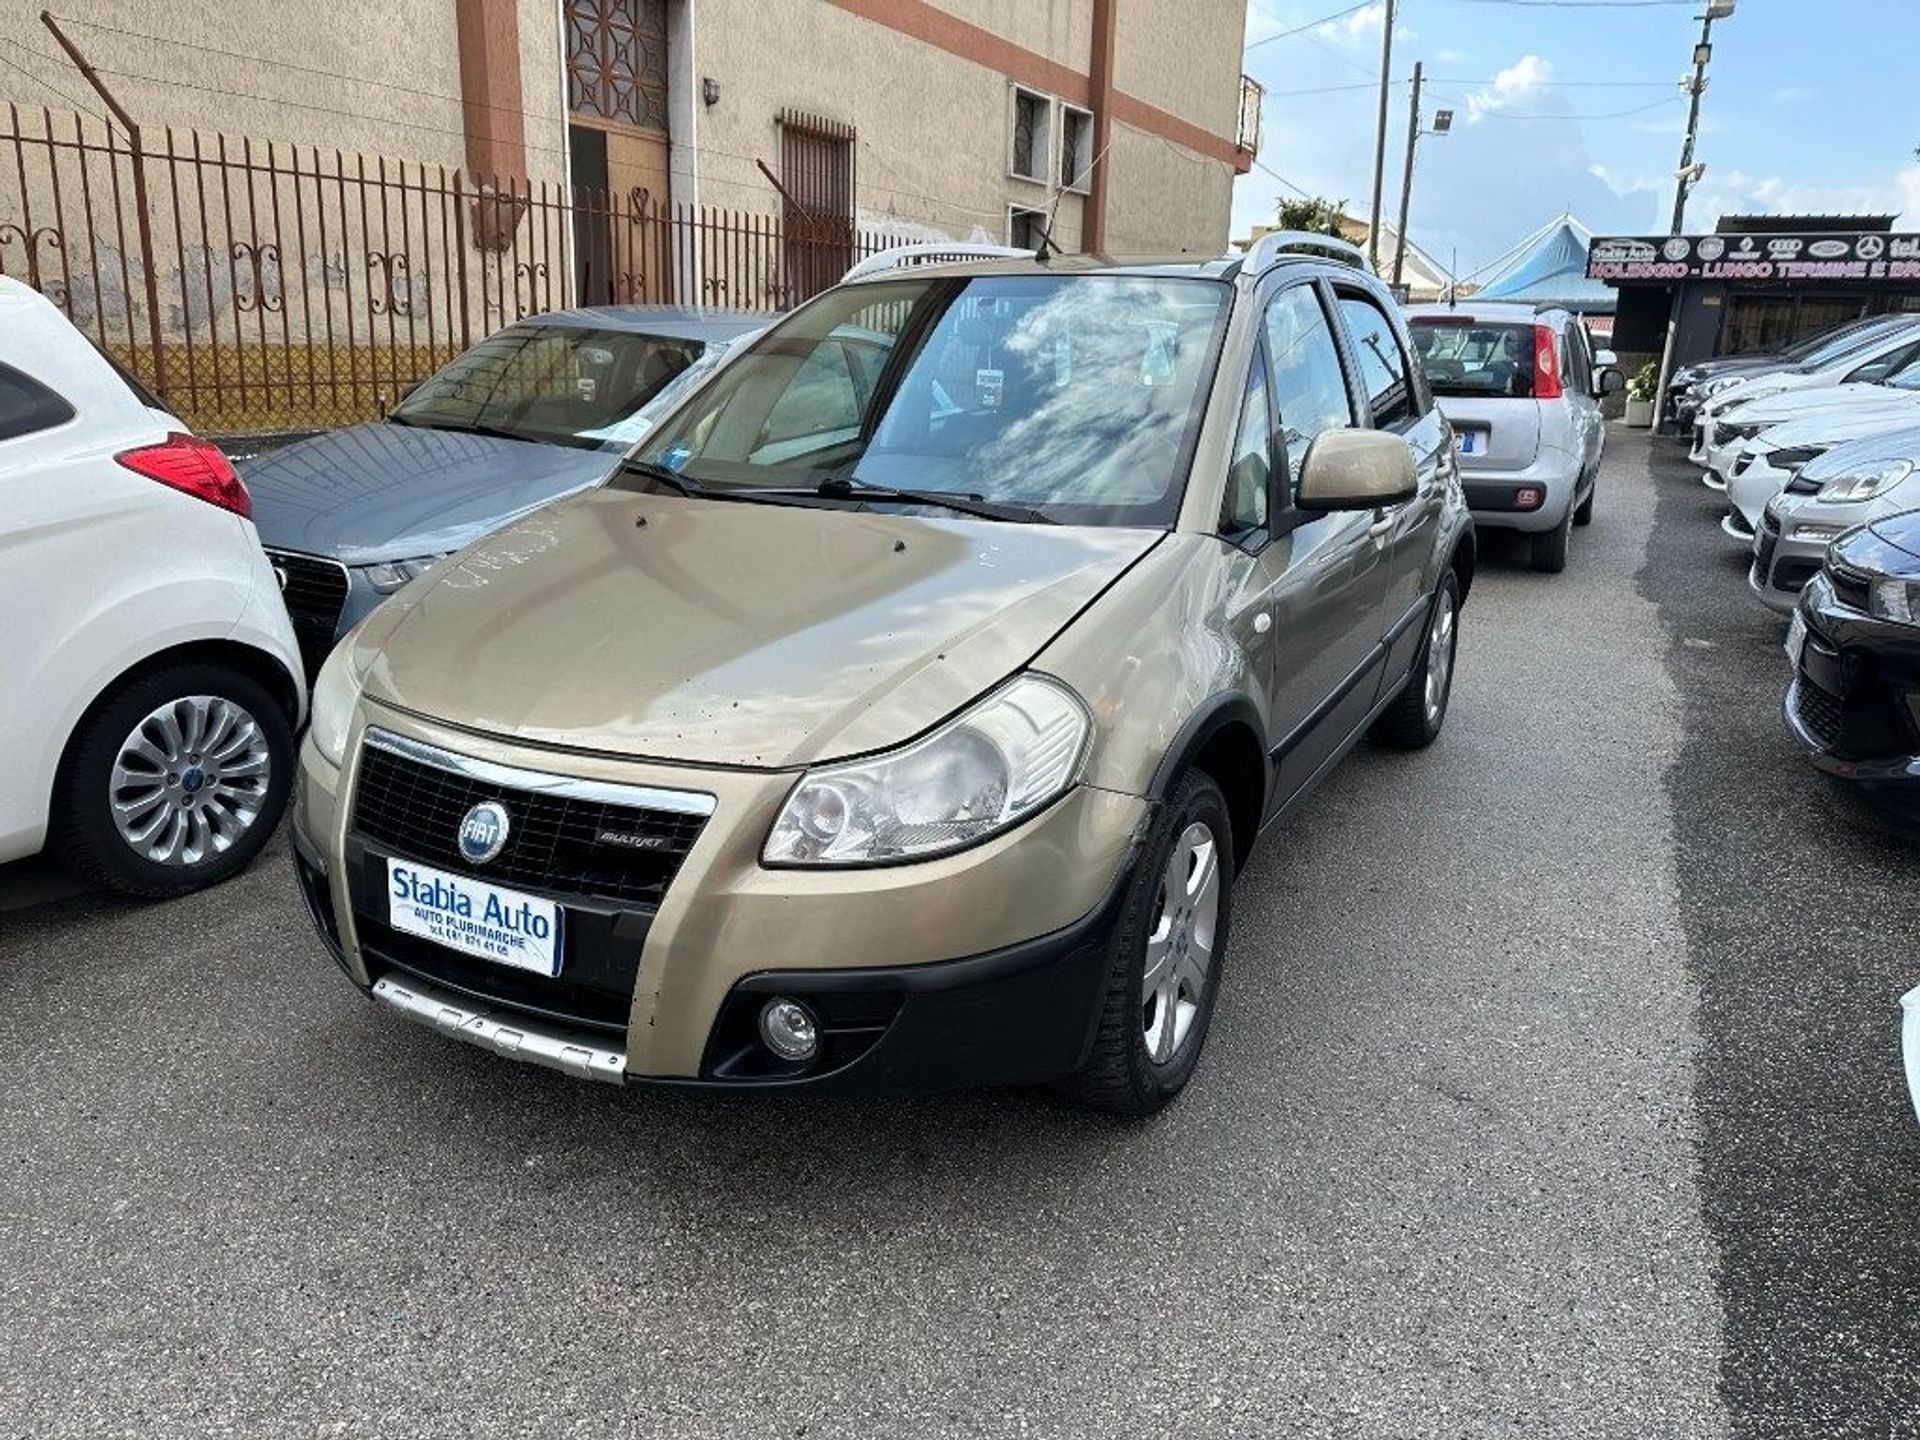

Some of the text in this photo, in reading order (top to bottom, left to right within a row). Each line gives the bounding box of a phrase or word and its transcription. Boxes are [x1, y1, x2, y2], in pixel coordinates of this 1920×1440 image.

[1702, 262, 1773, 278] LUNGO
[1776, 260, 1866, 278] TERMINE
[464, 819, 497, 845] FIAT
[393, 867, 549, 939] Stabia Auto
[414, 907, 526, 949] AUTO PLURIMARCHE
